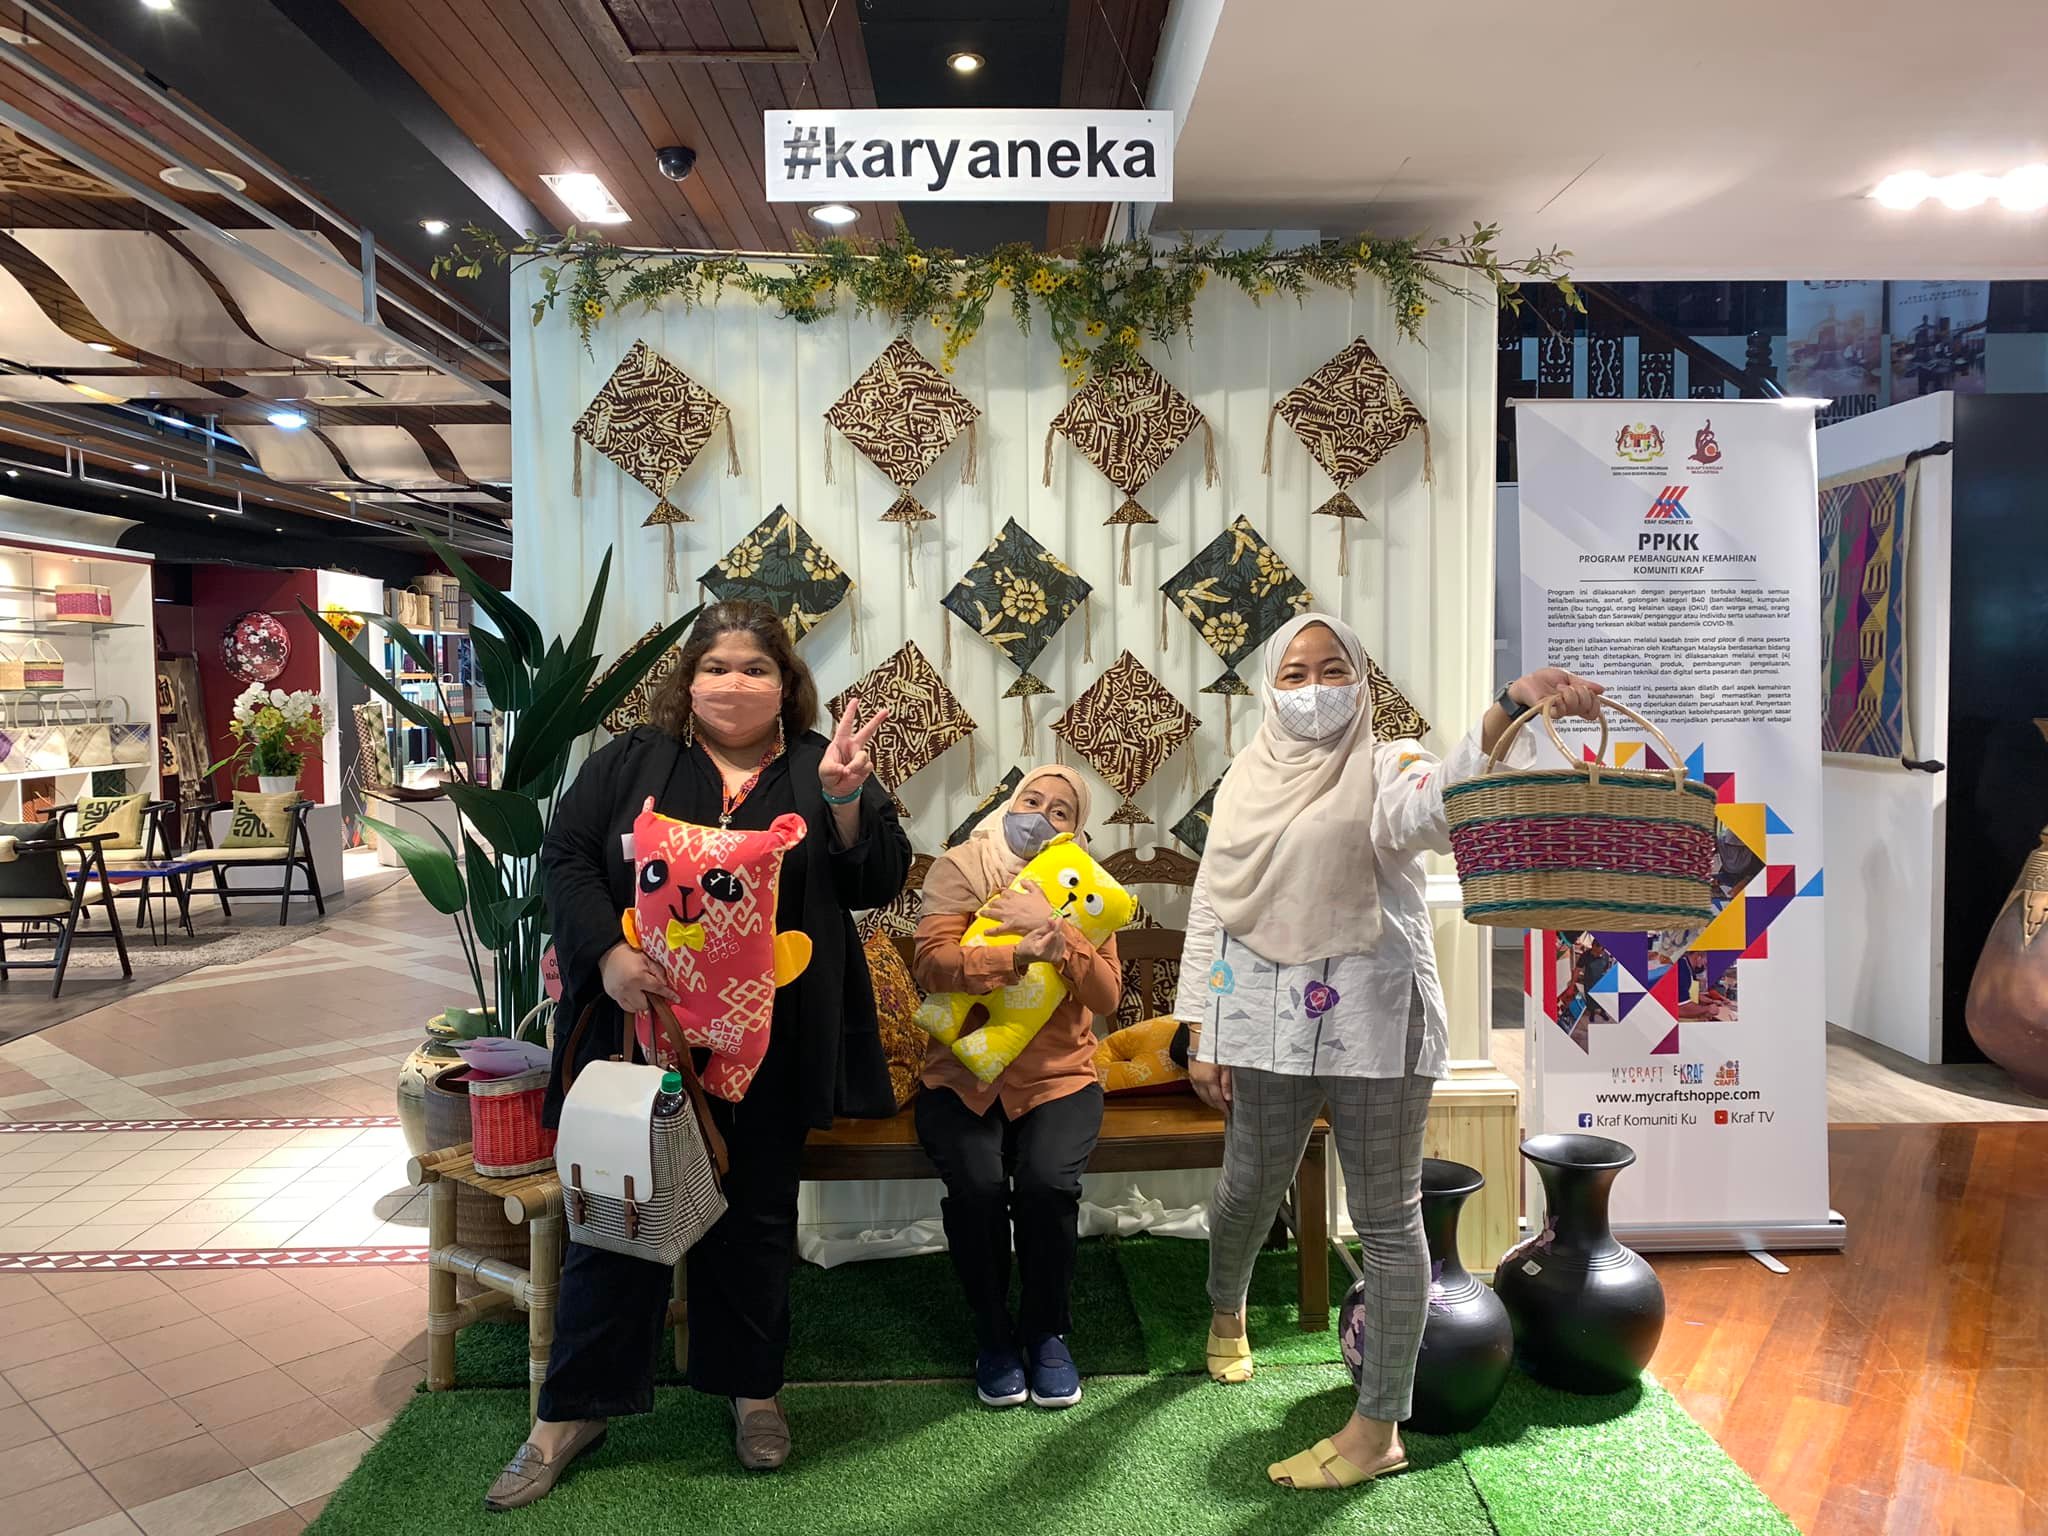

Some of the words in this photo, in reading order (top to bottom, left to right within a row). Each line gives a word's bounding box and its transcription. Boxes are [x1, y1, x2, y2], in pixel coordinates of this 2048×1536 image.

[783, 126, 1157, 192] #karyaneka
[1638, 533, 1700, 551] PPKK
[1579, 555, 1625, 564] PROGRAM
[1628, 554, 1700, 564] PEMBANGUNAN
[1702, 554, 1757, 563] KEMAHIRAN
[1633, 566, 1678, 575] KOMUNITI
[1681, 566, 1704, 575] KRAF
[1612, 1066, 1664, 1078] MYCRAFT
[1674, 1064, 1704, 1081] E-KRAF
[1596, 1090, 1760, 1105] www.mycraftshoppe.com
[1596, 1114, 1620, 1126] Kraf
[1624, 1113, 1677, 1126] Komuniti
[1681, 1113, 1697, 1125] Ku
[1731, 1112, 1754, 1123] Kraf
[1758, 1111, 1774, 1122] TV
